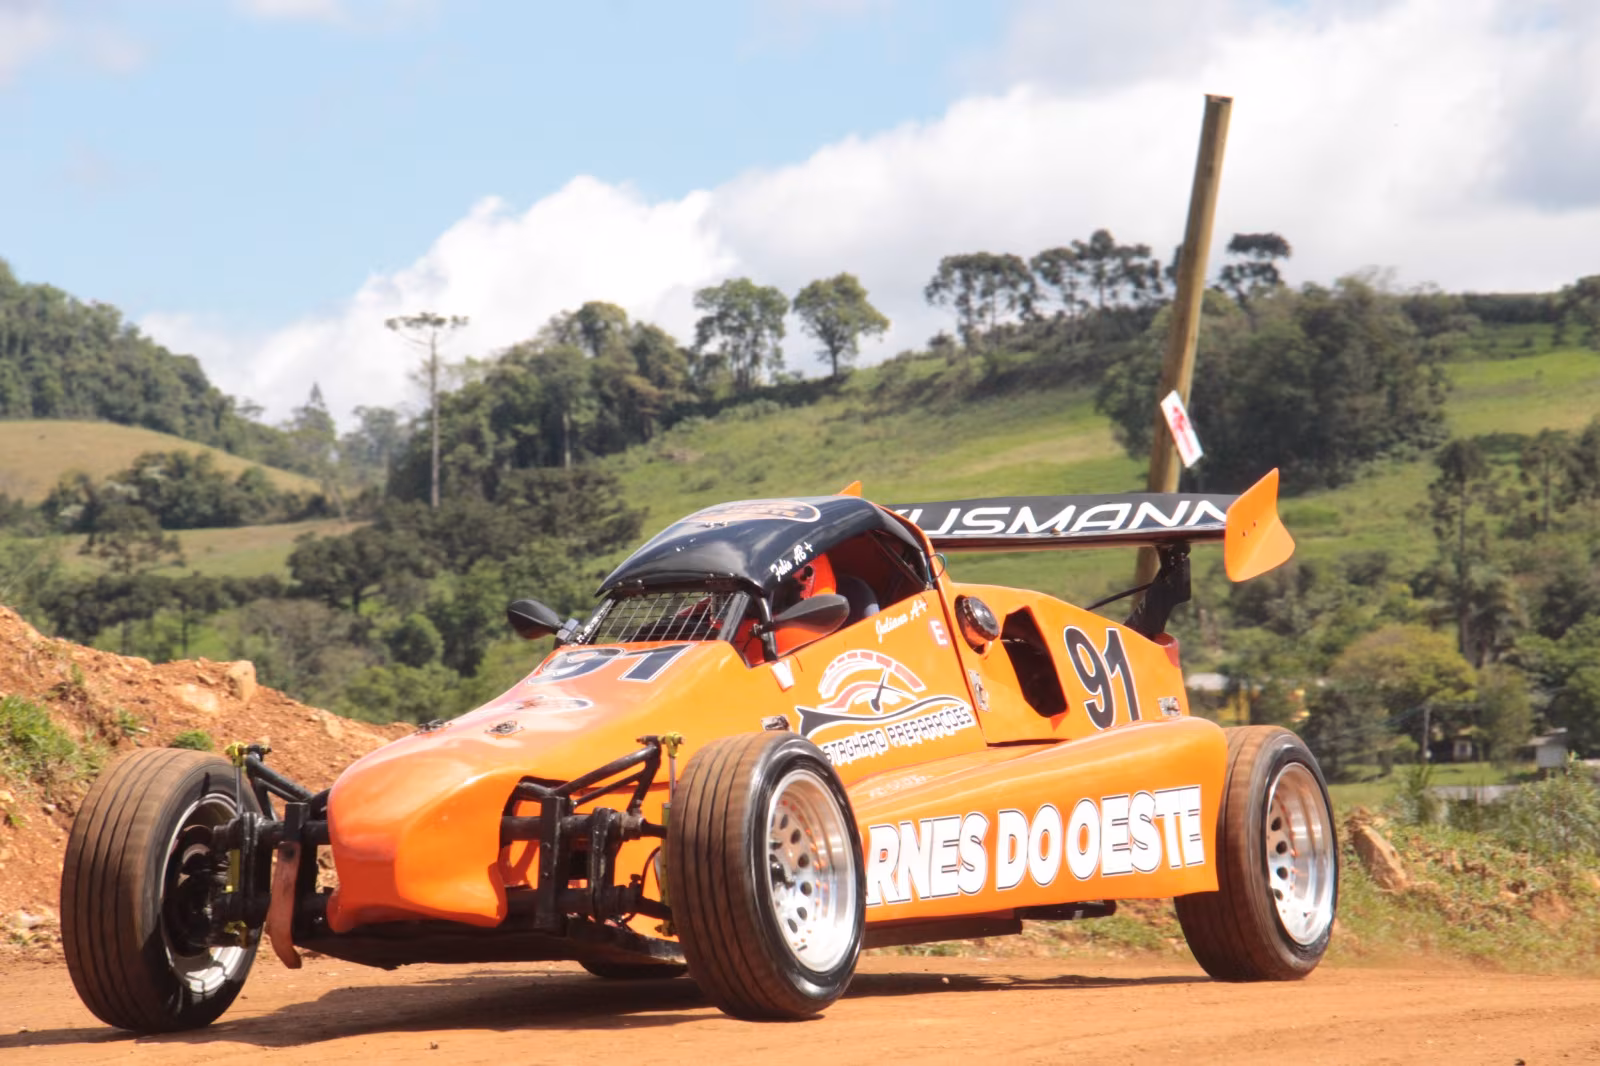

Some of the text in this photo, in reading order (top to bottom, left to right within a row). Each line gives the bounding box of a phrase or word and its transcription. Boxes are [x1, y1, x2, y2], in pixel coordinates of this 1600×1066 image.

[894, 500, 1227, 535] USMANN
[929, 620, 948, 645] E
[527, 643, 698, 682] 91
[1063, 626, 1141, 730] 91
[820, 729, 887, 765] STAGHARO
[862, 812, 990, 906] RNES
